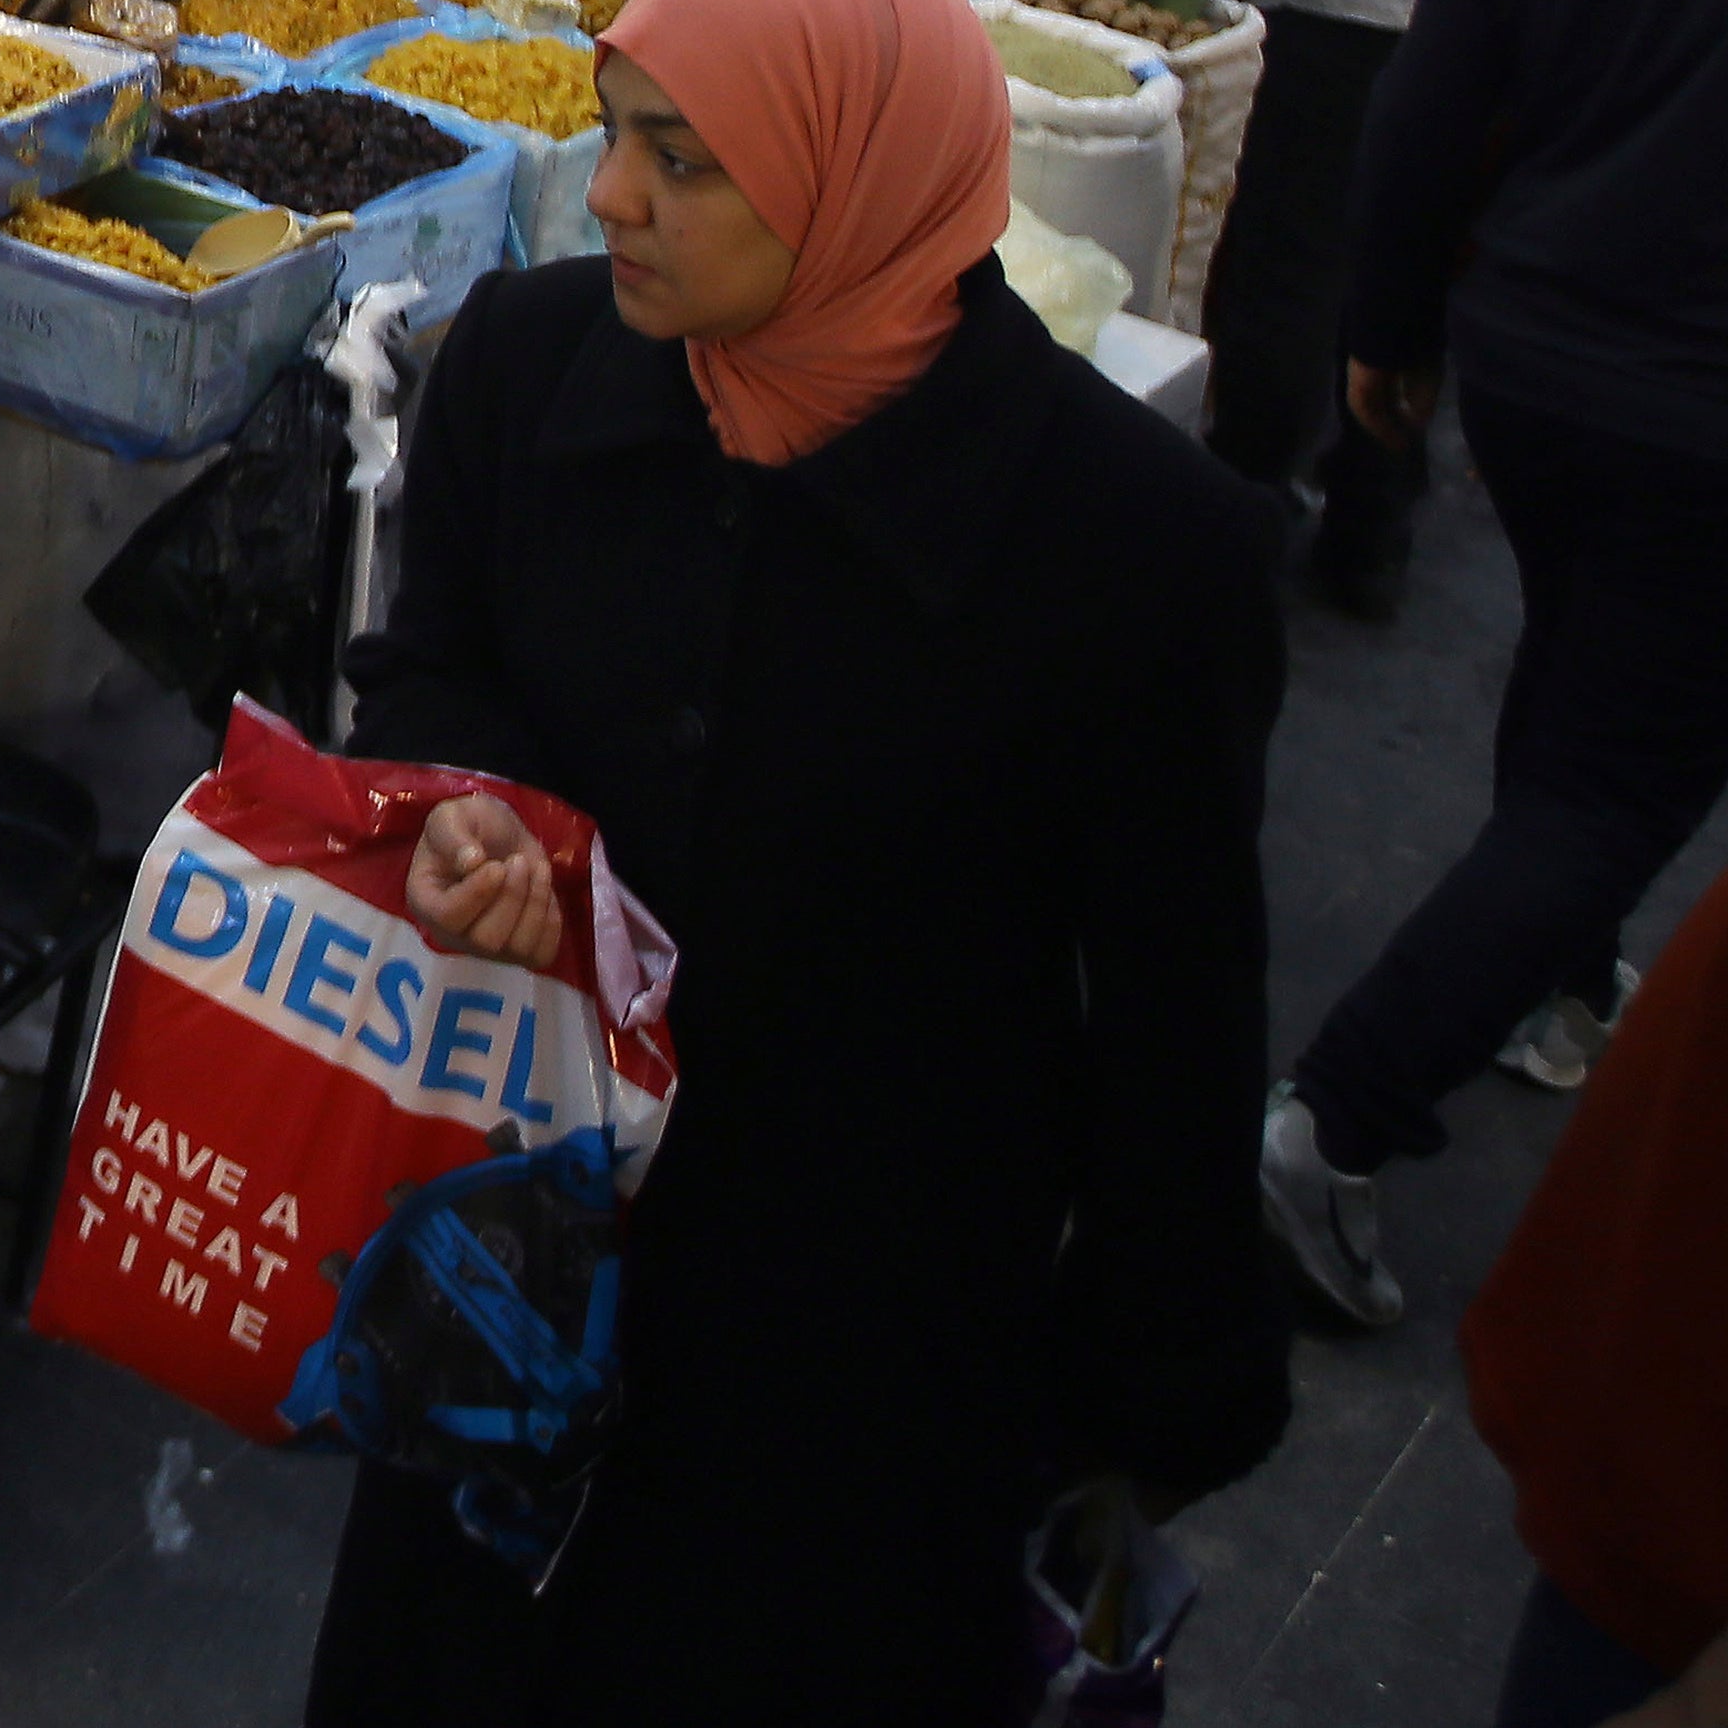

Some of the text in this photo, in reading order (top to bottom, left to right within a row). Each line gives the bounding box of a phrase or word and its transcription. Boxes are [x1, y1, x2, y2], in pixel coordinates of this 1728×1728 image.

[147, 847, 555, 1125] DIESEL
[90, 1145, 289, 1293] GREAT
[103, 1087, 301, 1242] HAVE A
